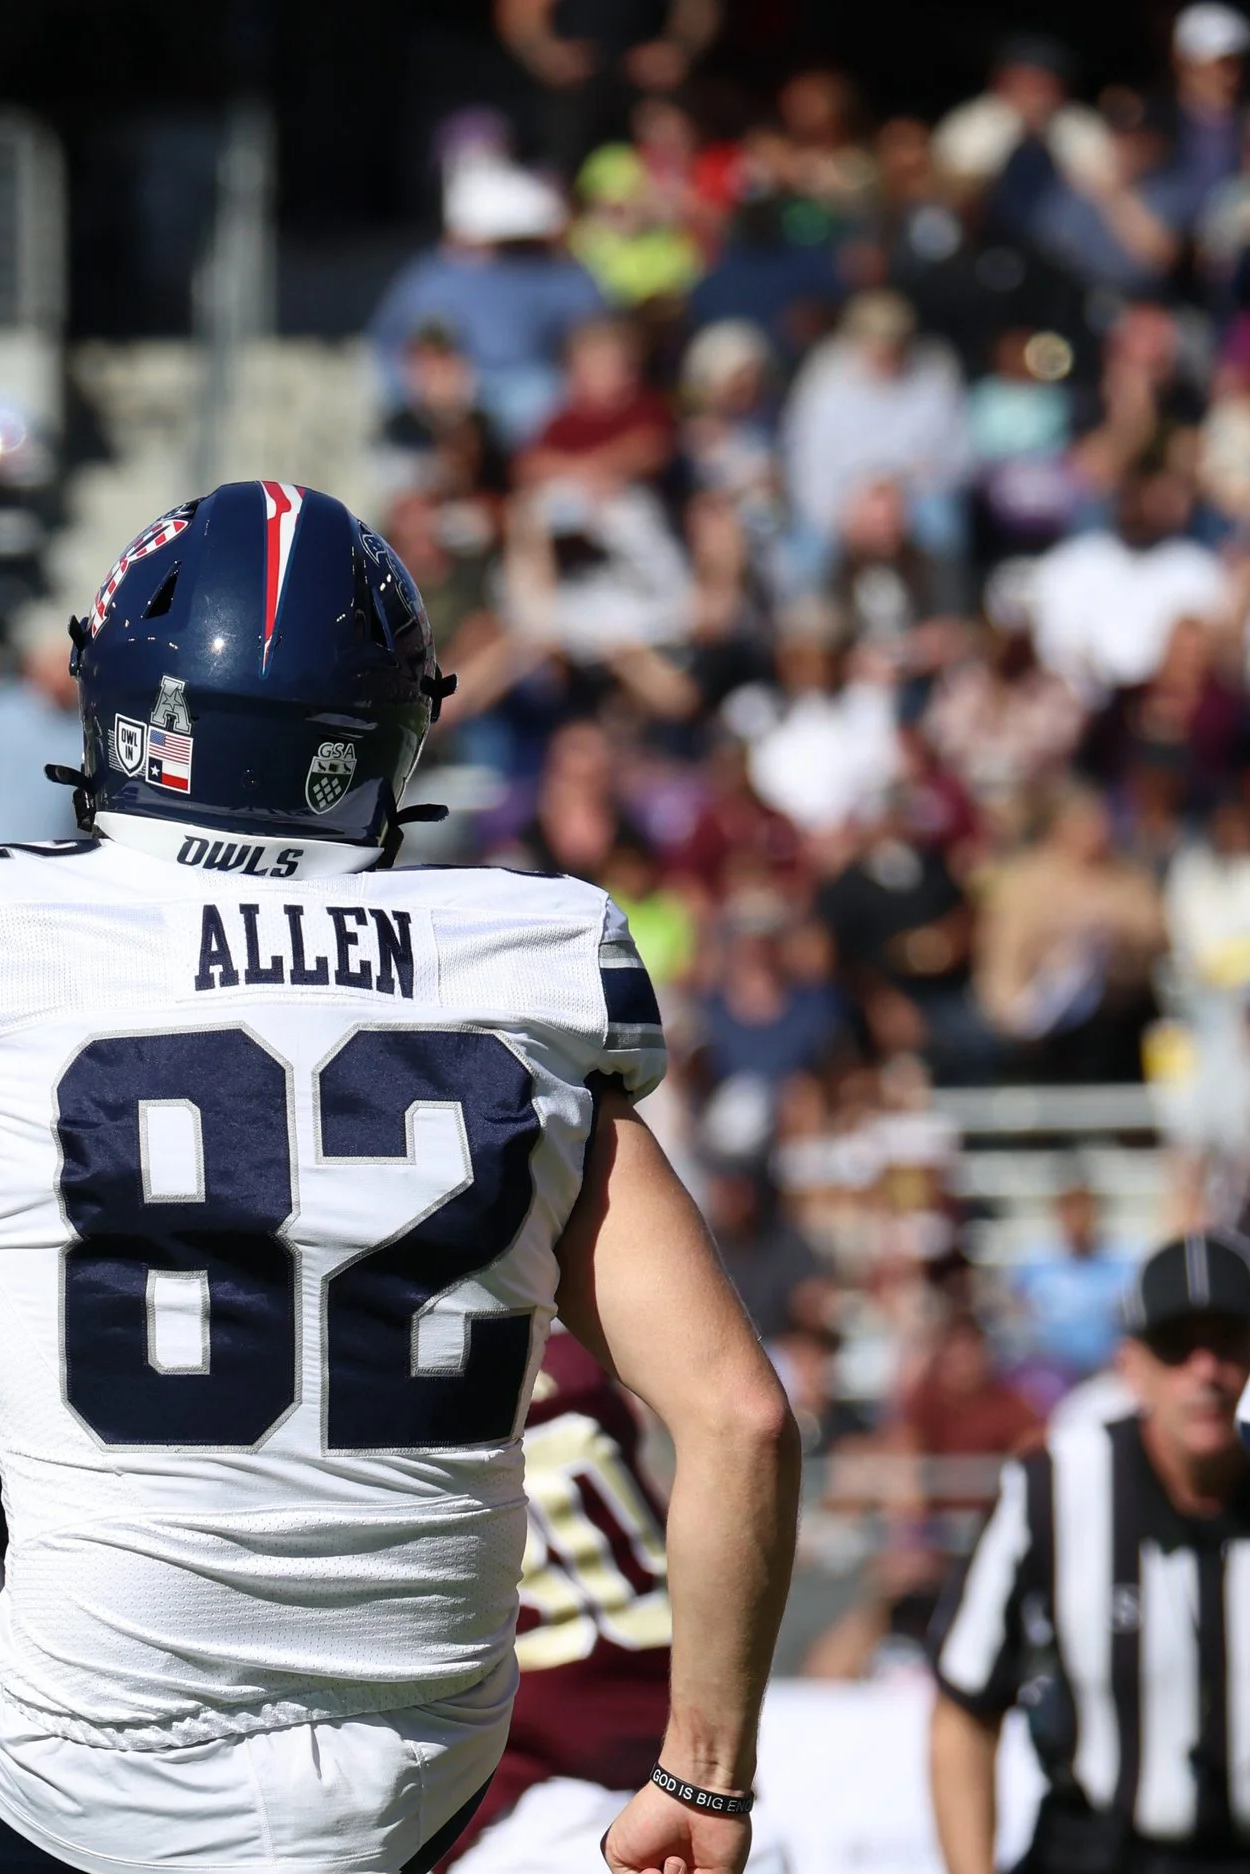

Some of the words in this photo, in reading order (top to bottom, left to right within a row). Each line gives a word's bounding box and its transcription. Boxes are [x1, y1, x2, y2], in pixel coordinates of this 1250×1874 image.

[121, 728, 138, 747] OWL
[125, 745, 134, 761] IN
[318, 742, 355, 760] GSA
[177, 835, 304, 877] OWLS
[194, 903, 415, 999] ALLEN
[52, 1021, 547, 1456] 82
[652, 1769, 677, 1791] GOD
[678, 1784, 693, 1800] IS
[696, 1792, 724, 1810] BIG
